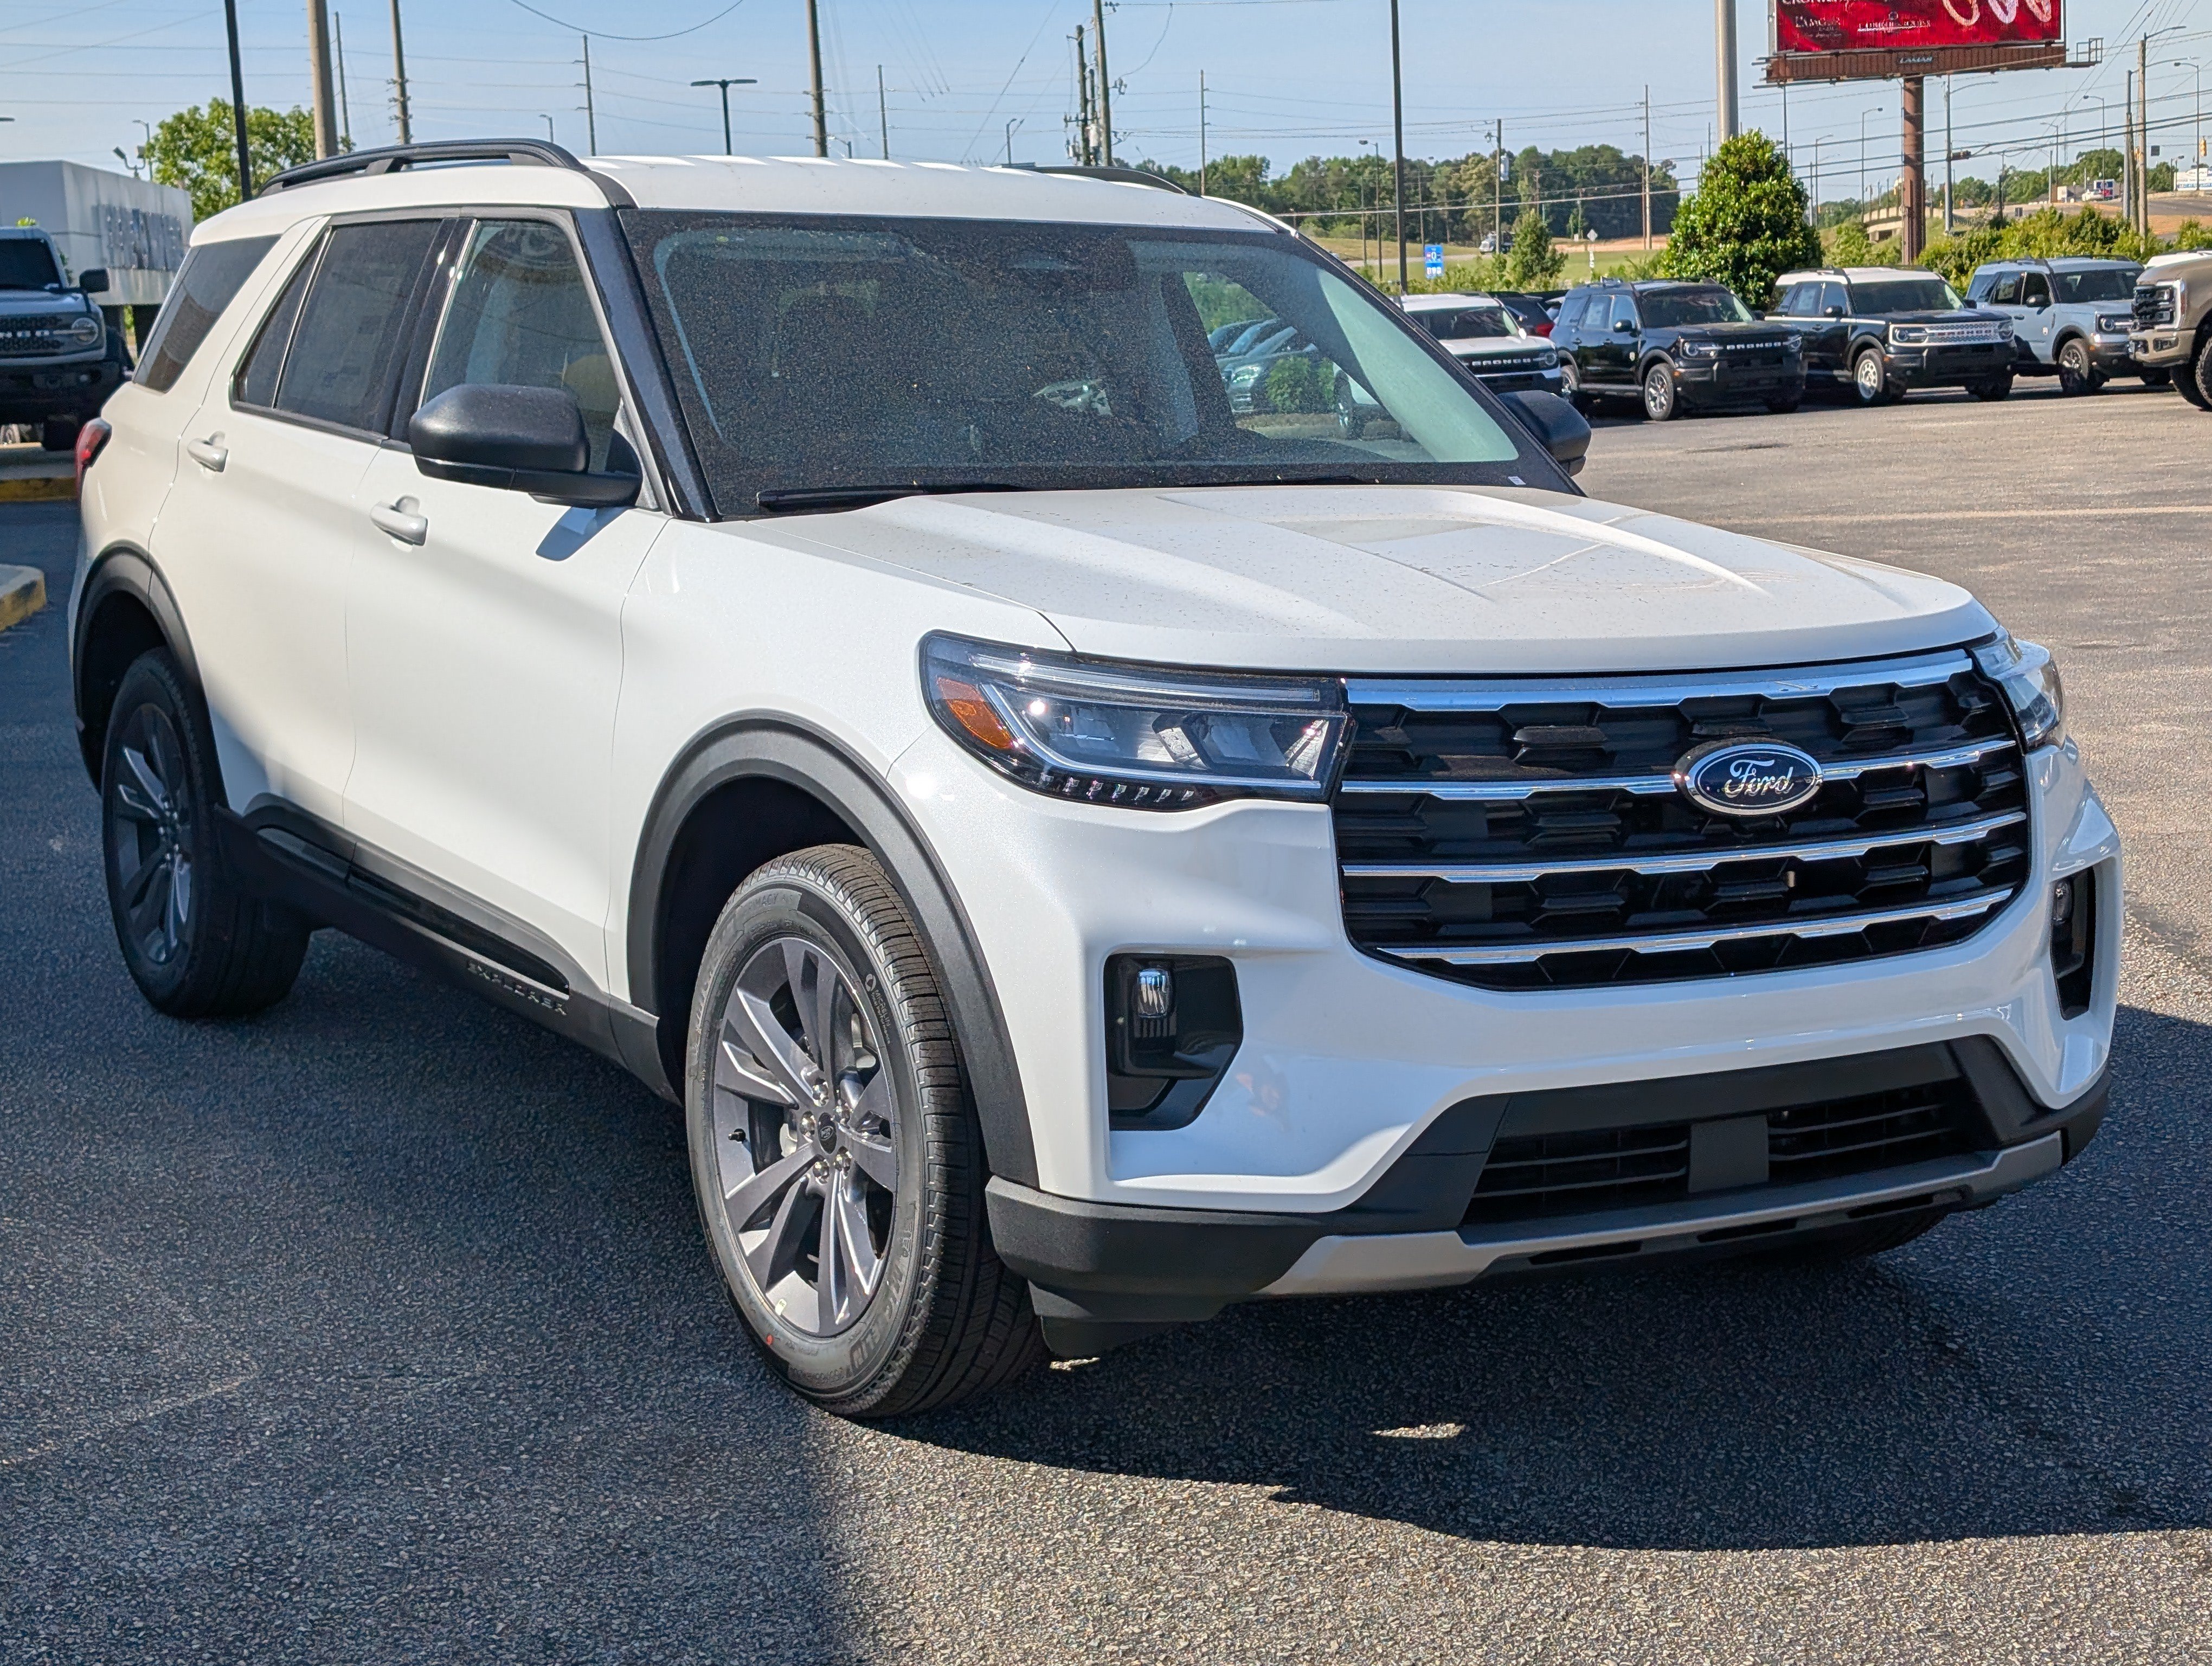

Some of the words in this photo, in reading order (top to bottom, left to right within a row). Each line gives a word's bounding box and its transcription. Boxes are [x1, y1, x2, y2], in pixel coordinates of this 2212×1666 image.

[1726, 342, 1782, 350] BRONCO
[1471, 358, 1531, 367] BRONCO
[1725, 759, 1795, 798] Ford
